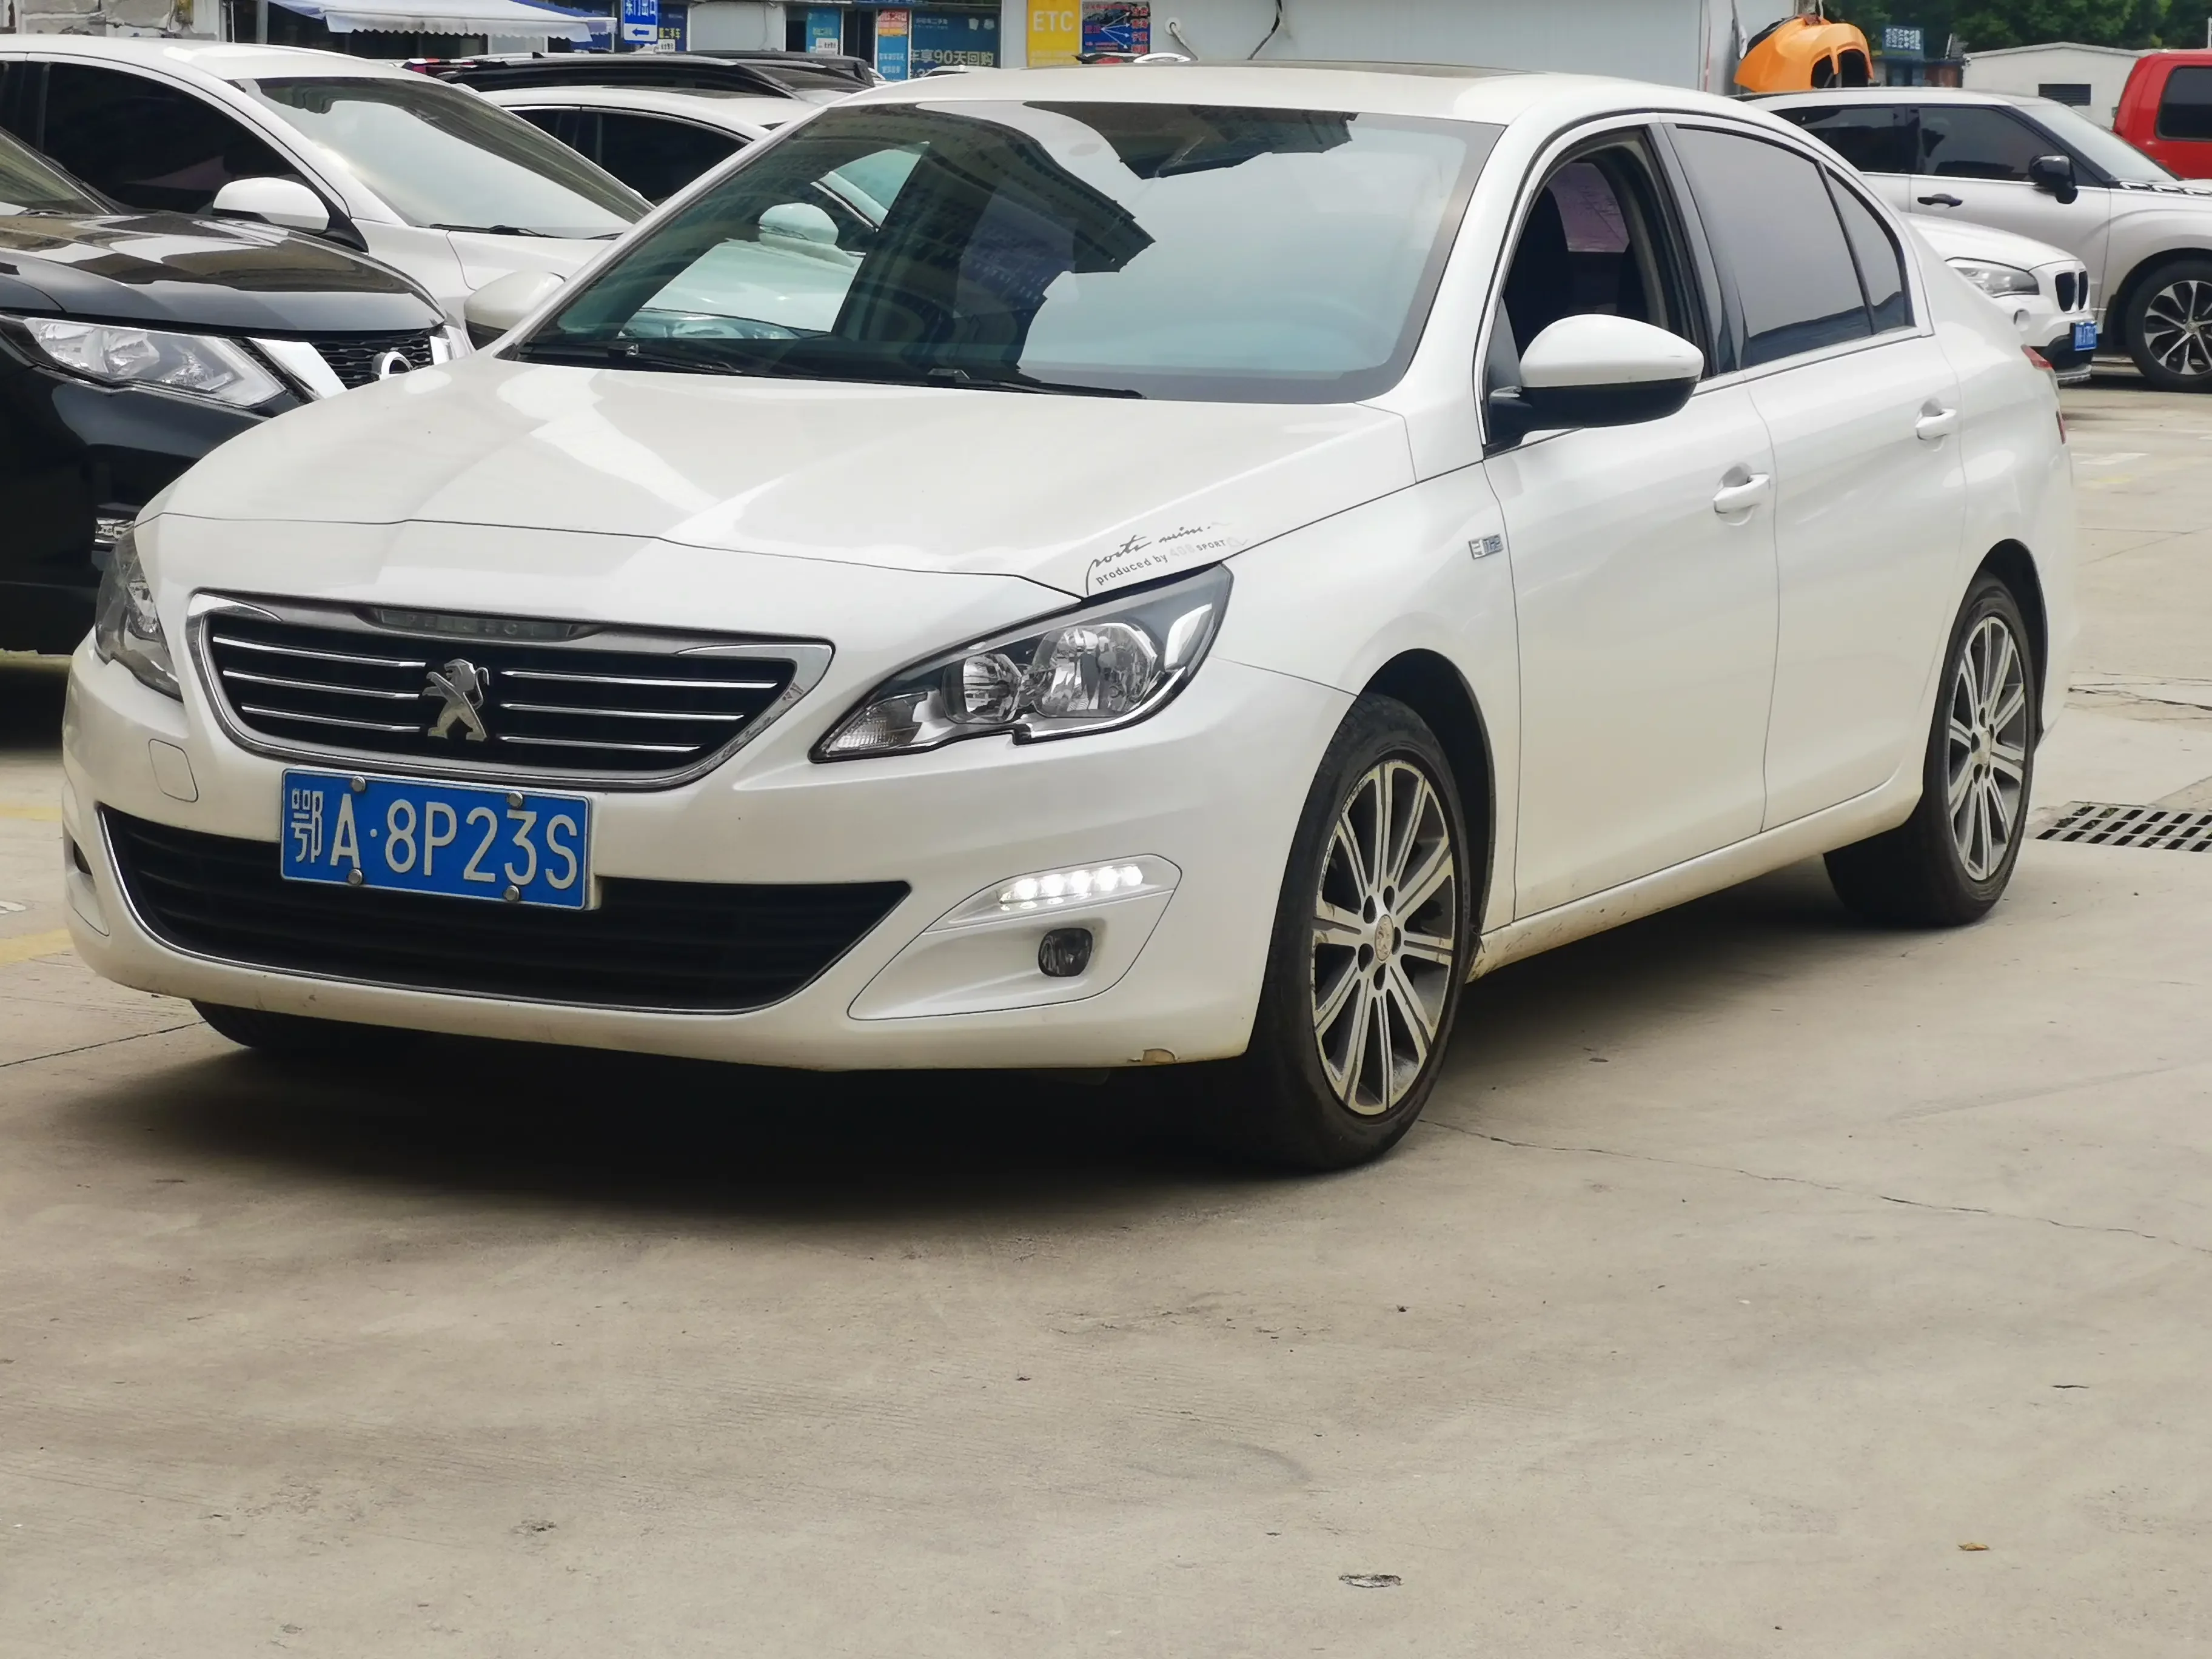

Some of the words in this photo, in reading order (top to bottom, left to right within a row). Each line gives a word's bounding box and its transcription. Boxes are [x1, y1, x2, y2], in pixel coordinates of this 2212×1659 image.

[1033, 10, 1074, 32] ETC
[1096, 557, 1152, 586] produced
[1152, 554, 1168, 563] by
[1196, 540, 1226, 551] SPORT
[290, 788, 578, 890] 鄂A·8P23S
